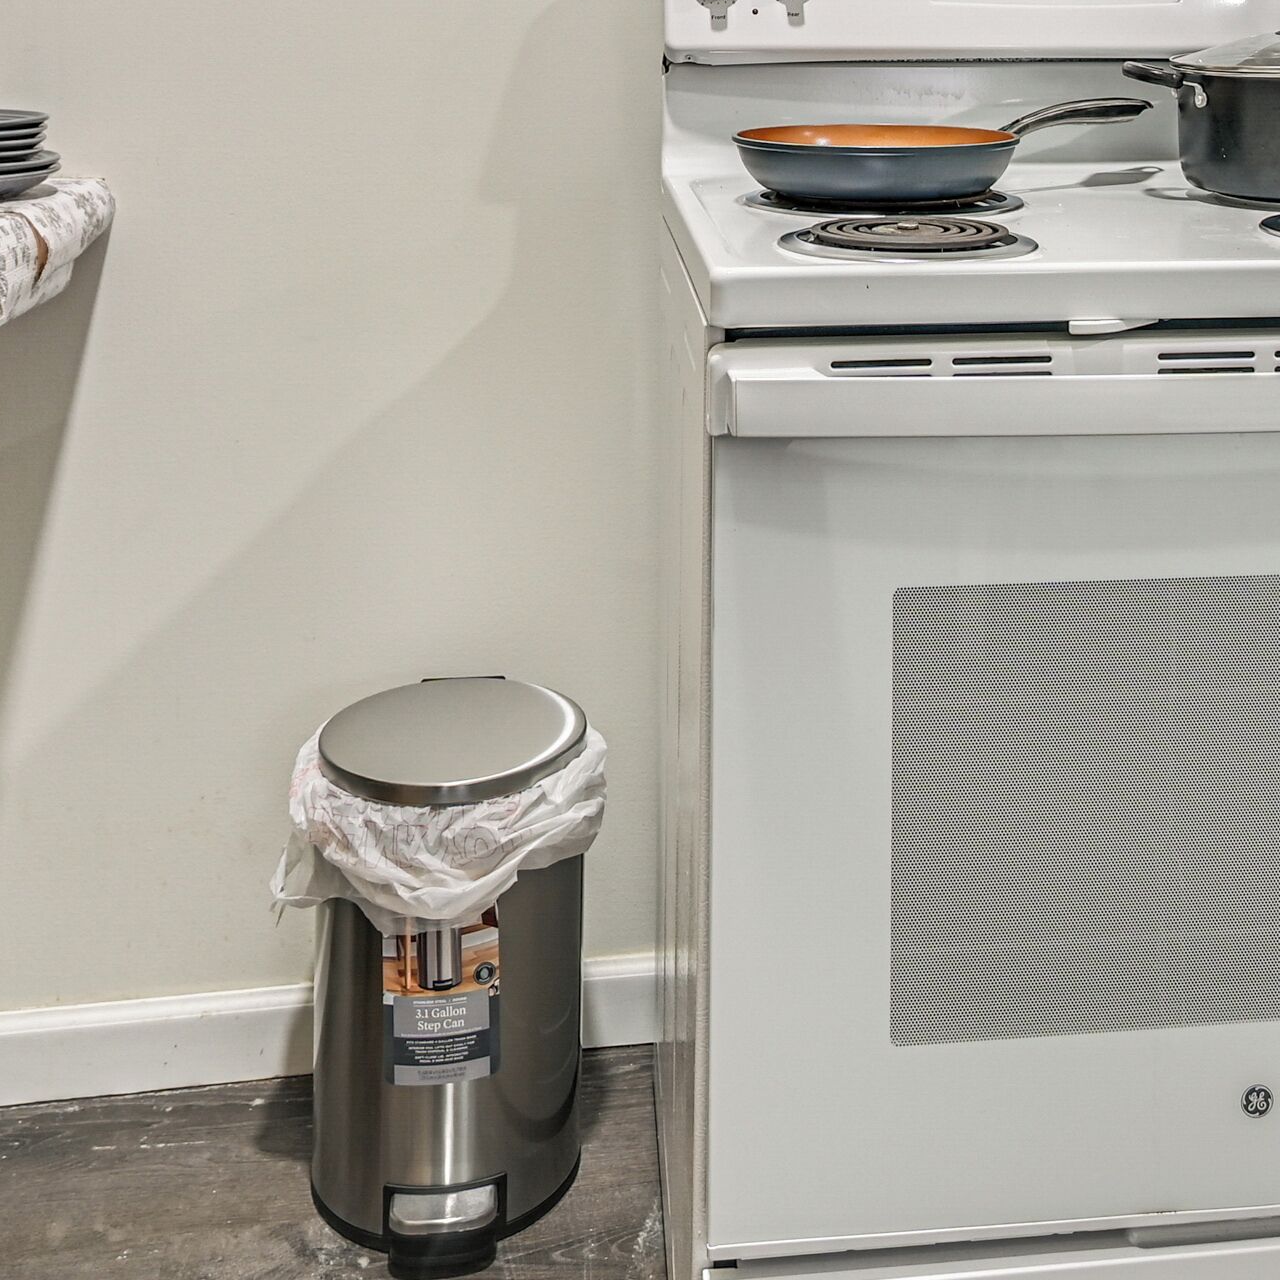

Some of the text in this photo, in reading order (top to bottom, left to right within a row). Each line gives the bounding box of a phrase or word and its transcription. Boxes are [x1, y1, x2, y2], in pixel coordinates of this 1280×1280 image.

[415, 1006, 466, 1019] 3.1 Gallon
[417, 1020, 441, 1033] Step
[443, 1019, 465, 1030] Can
